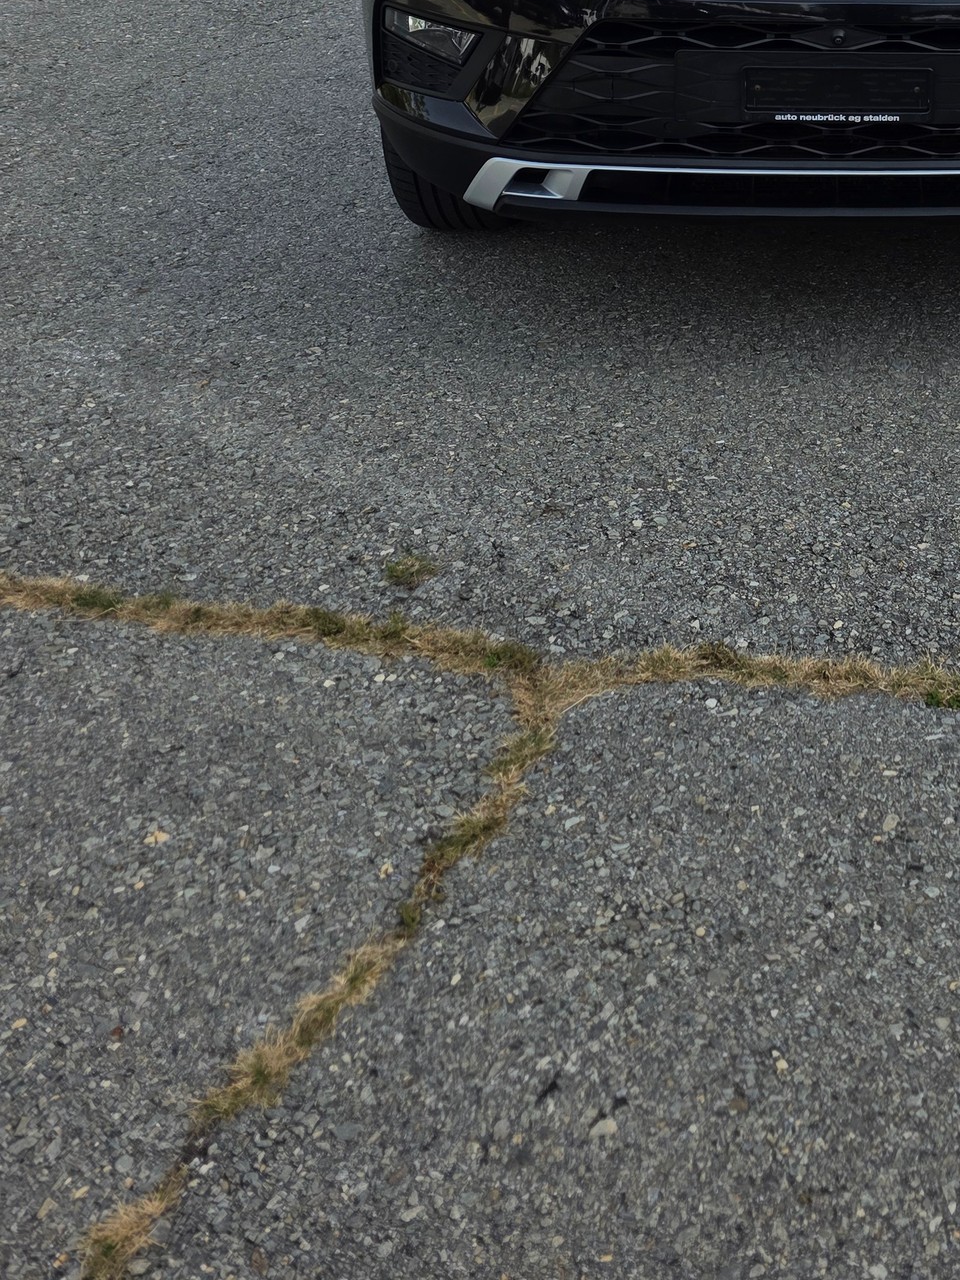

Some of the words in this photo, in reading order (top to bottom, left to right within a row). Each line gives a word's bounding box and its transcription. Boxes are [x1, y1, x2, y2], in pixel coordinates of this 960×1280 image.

[800, 113, 846, 121] neubrück
[848, 115, 861, 123] ag
[863, 114, 900, 122] stalden
